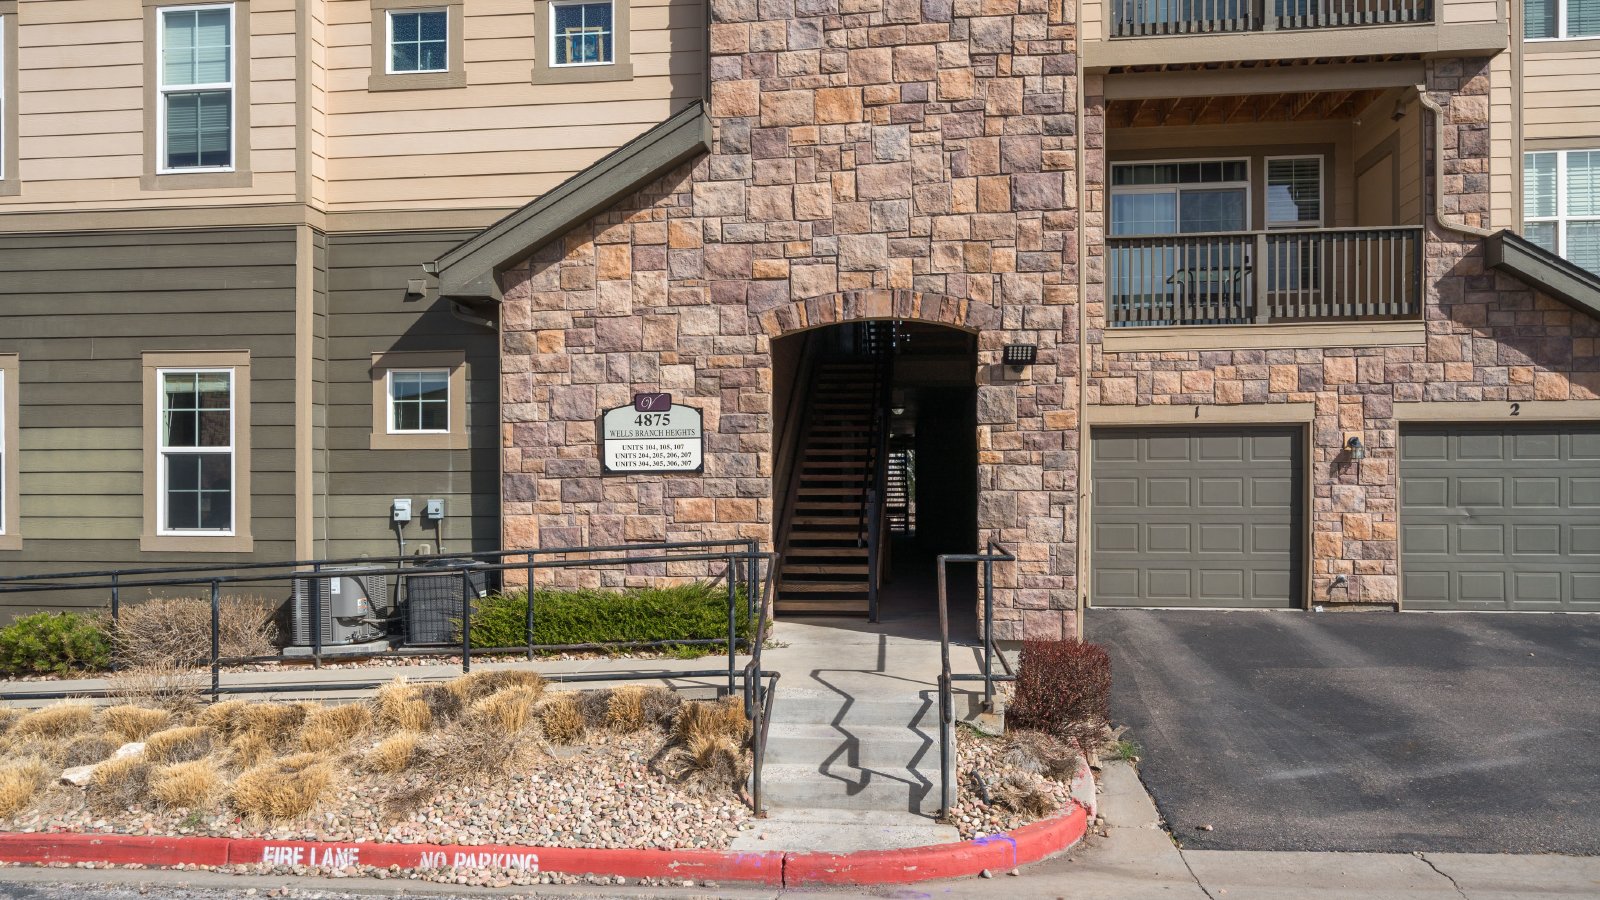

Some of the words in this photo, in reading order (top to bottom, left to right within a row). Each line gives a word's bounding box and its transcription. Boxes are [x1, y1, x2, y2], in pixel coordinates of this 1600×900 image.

[1194, 405, 1200, 419] 1
[1509, 402, 1521, 416] 2
[634, 413, 671, 426] 4875
[610, 430, 633, 438] WELLS
[635, 429, 664, 437] BRANCH
[665, 428, 696, 436] HEIGHTS
[263, 846, 304, 867] FIRE
[310, 847, 360, 868] LANE
[420, 851, 447, 869] NO
[454, 852, 539, 873] PARKING
